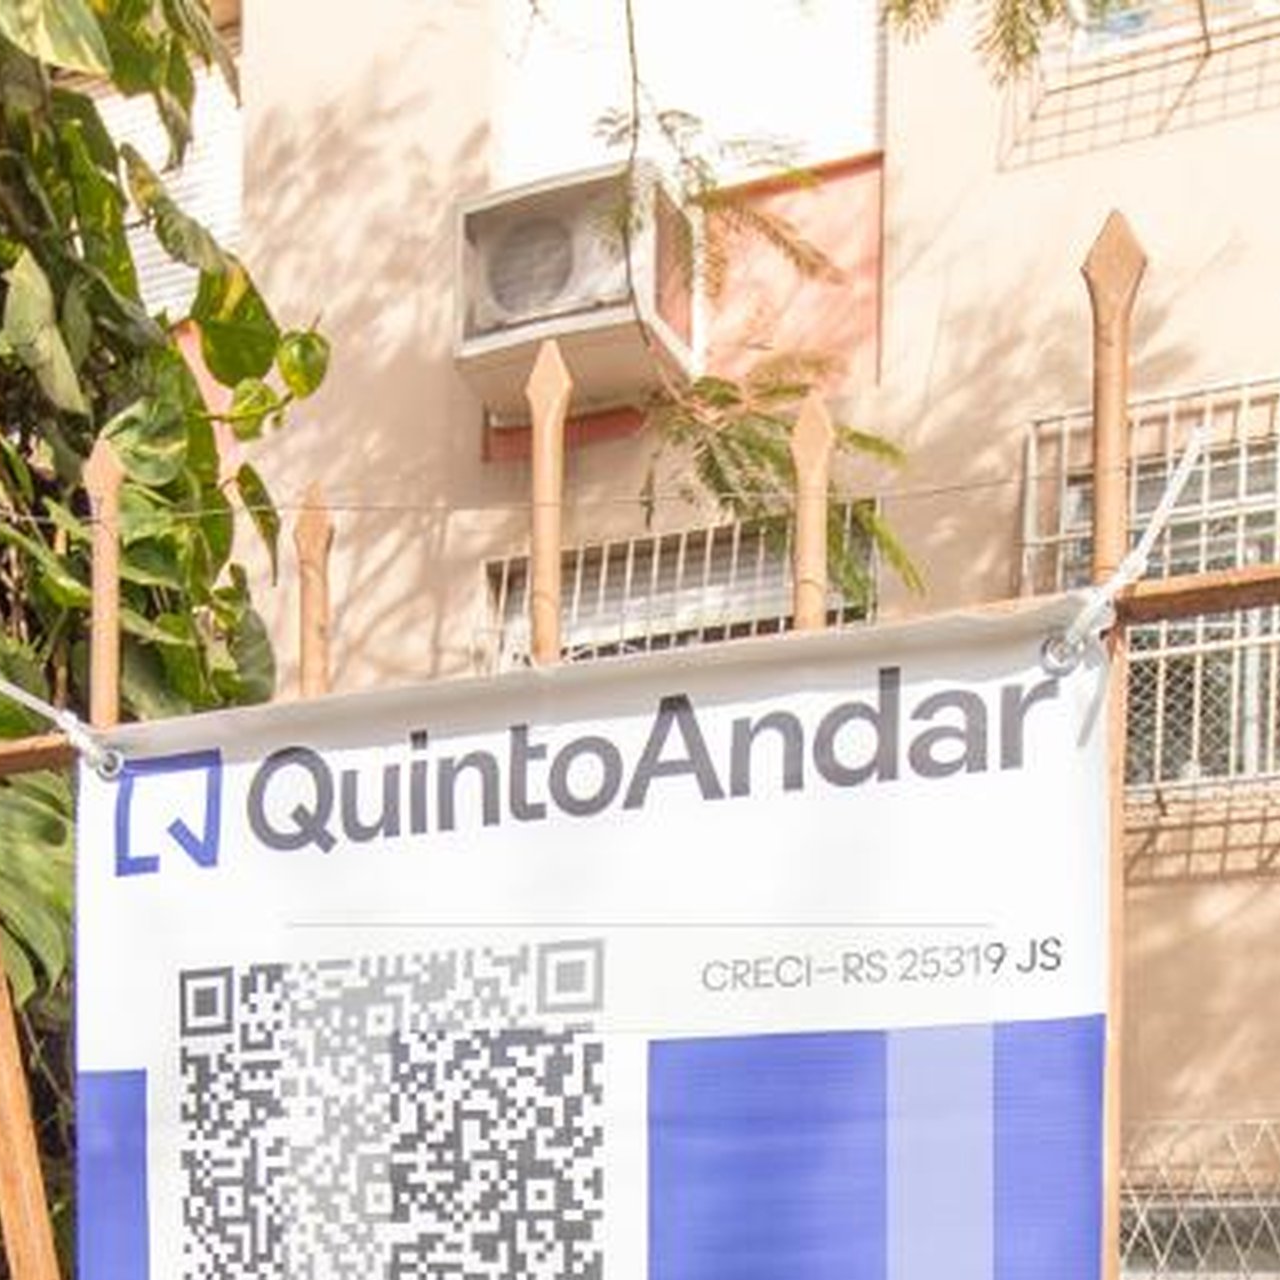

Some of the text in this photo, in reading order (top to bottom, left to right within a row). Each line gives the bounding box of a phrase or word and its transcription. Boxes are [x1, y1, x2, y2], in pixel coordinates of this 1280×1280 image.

[246, 667, 1062, 854] QuintoAndar
[702, 937, 1062, 991] CRECI-RS 25319 JS
